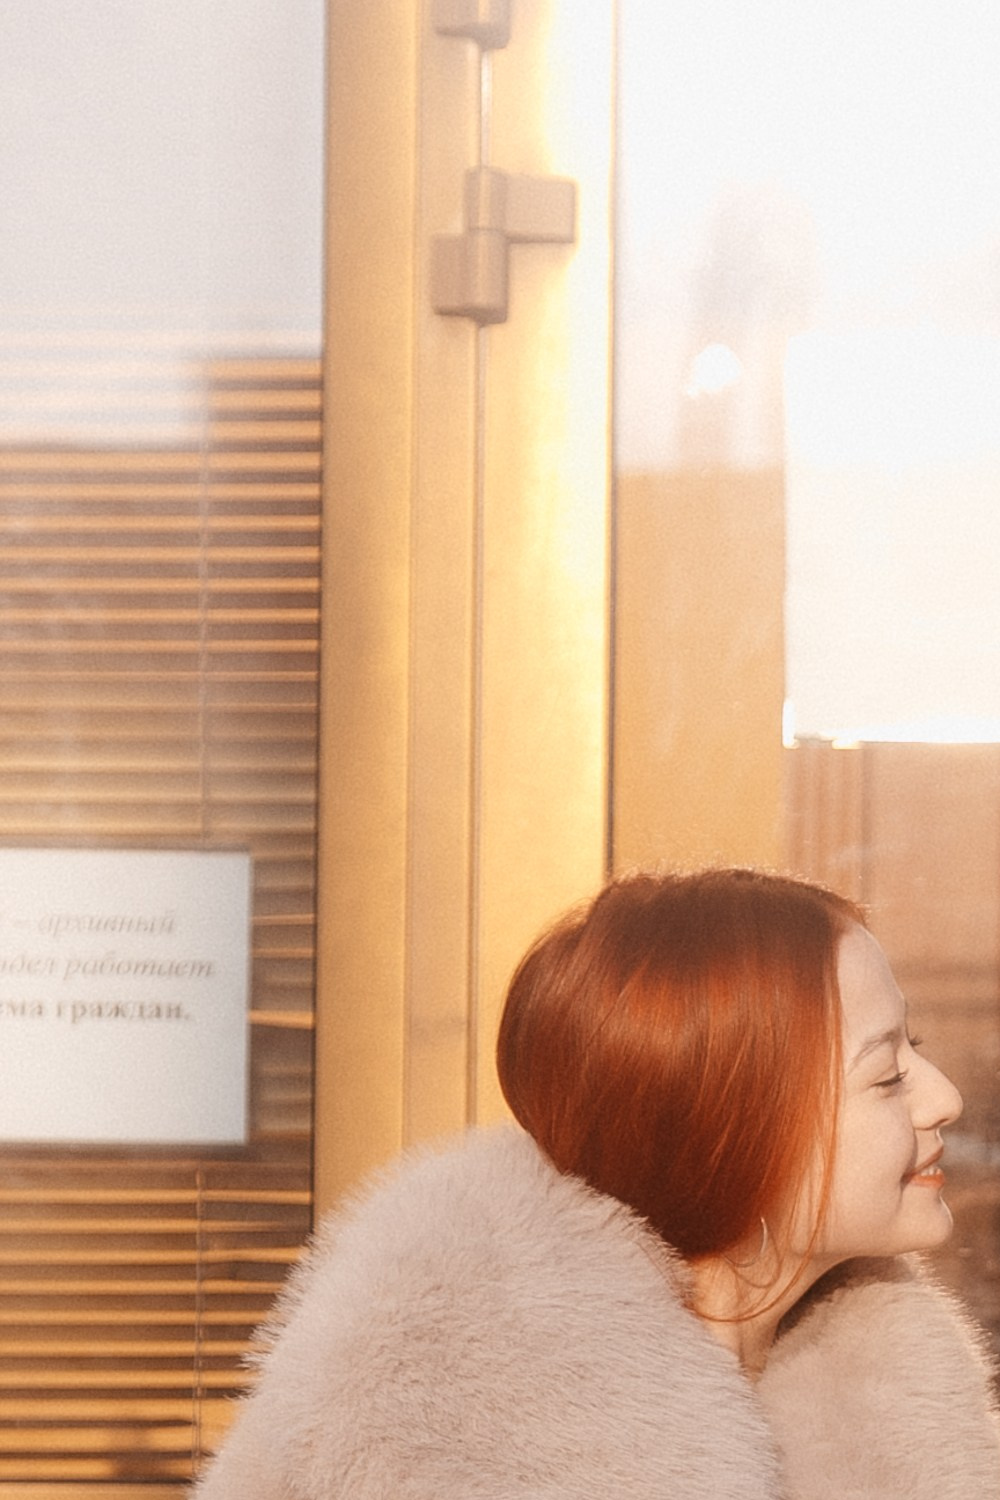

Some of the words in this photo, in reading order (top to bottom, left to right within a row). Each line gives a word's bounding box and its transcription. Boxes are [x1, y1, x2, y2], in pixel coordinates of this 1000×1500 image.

[0, 953, 55, 976] дел
[62, 950, 215, 981] работает
[55, 1000, 191, 1025] граждан.
